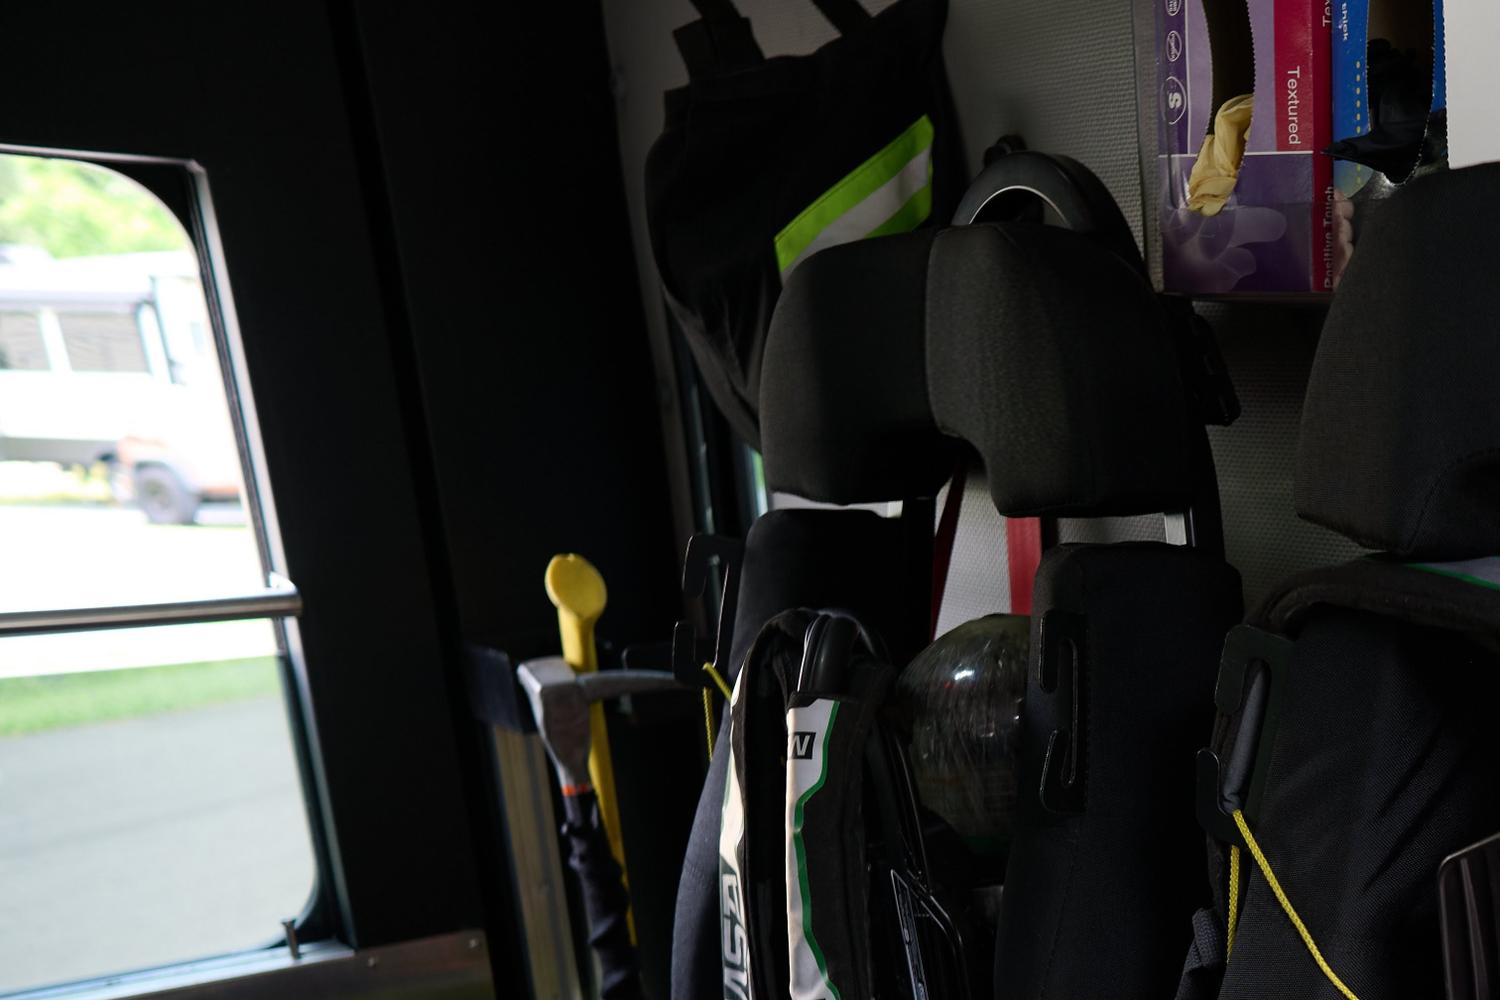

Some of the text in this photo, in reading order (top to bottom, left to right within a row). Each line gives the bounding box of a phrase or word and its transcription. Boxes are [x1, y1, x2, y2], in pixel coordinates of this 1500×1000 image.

[1287, 65, 1301, 145] Textured
[1324, 186, 1334, 289] Positive Touch
